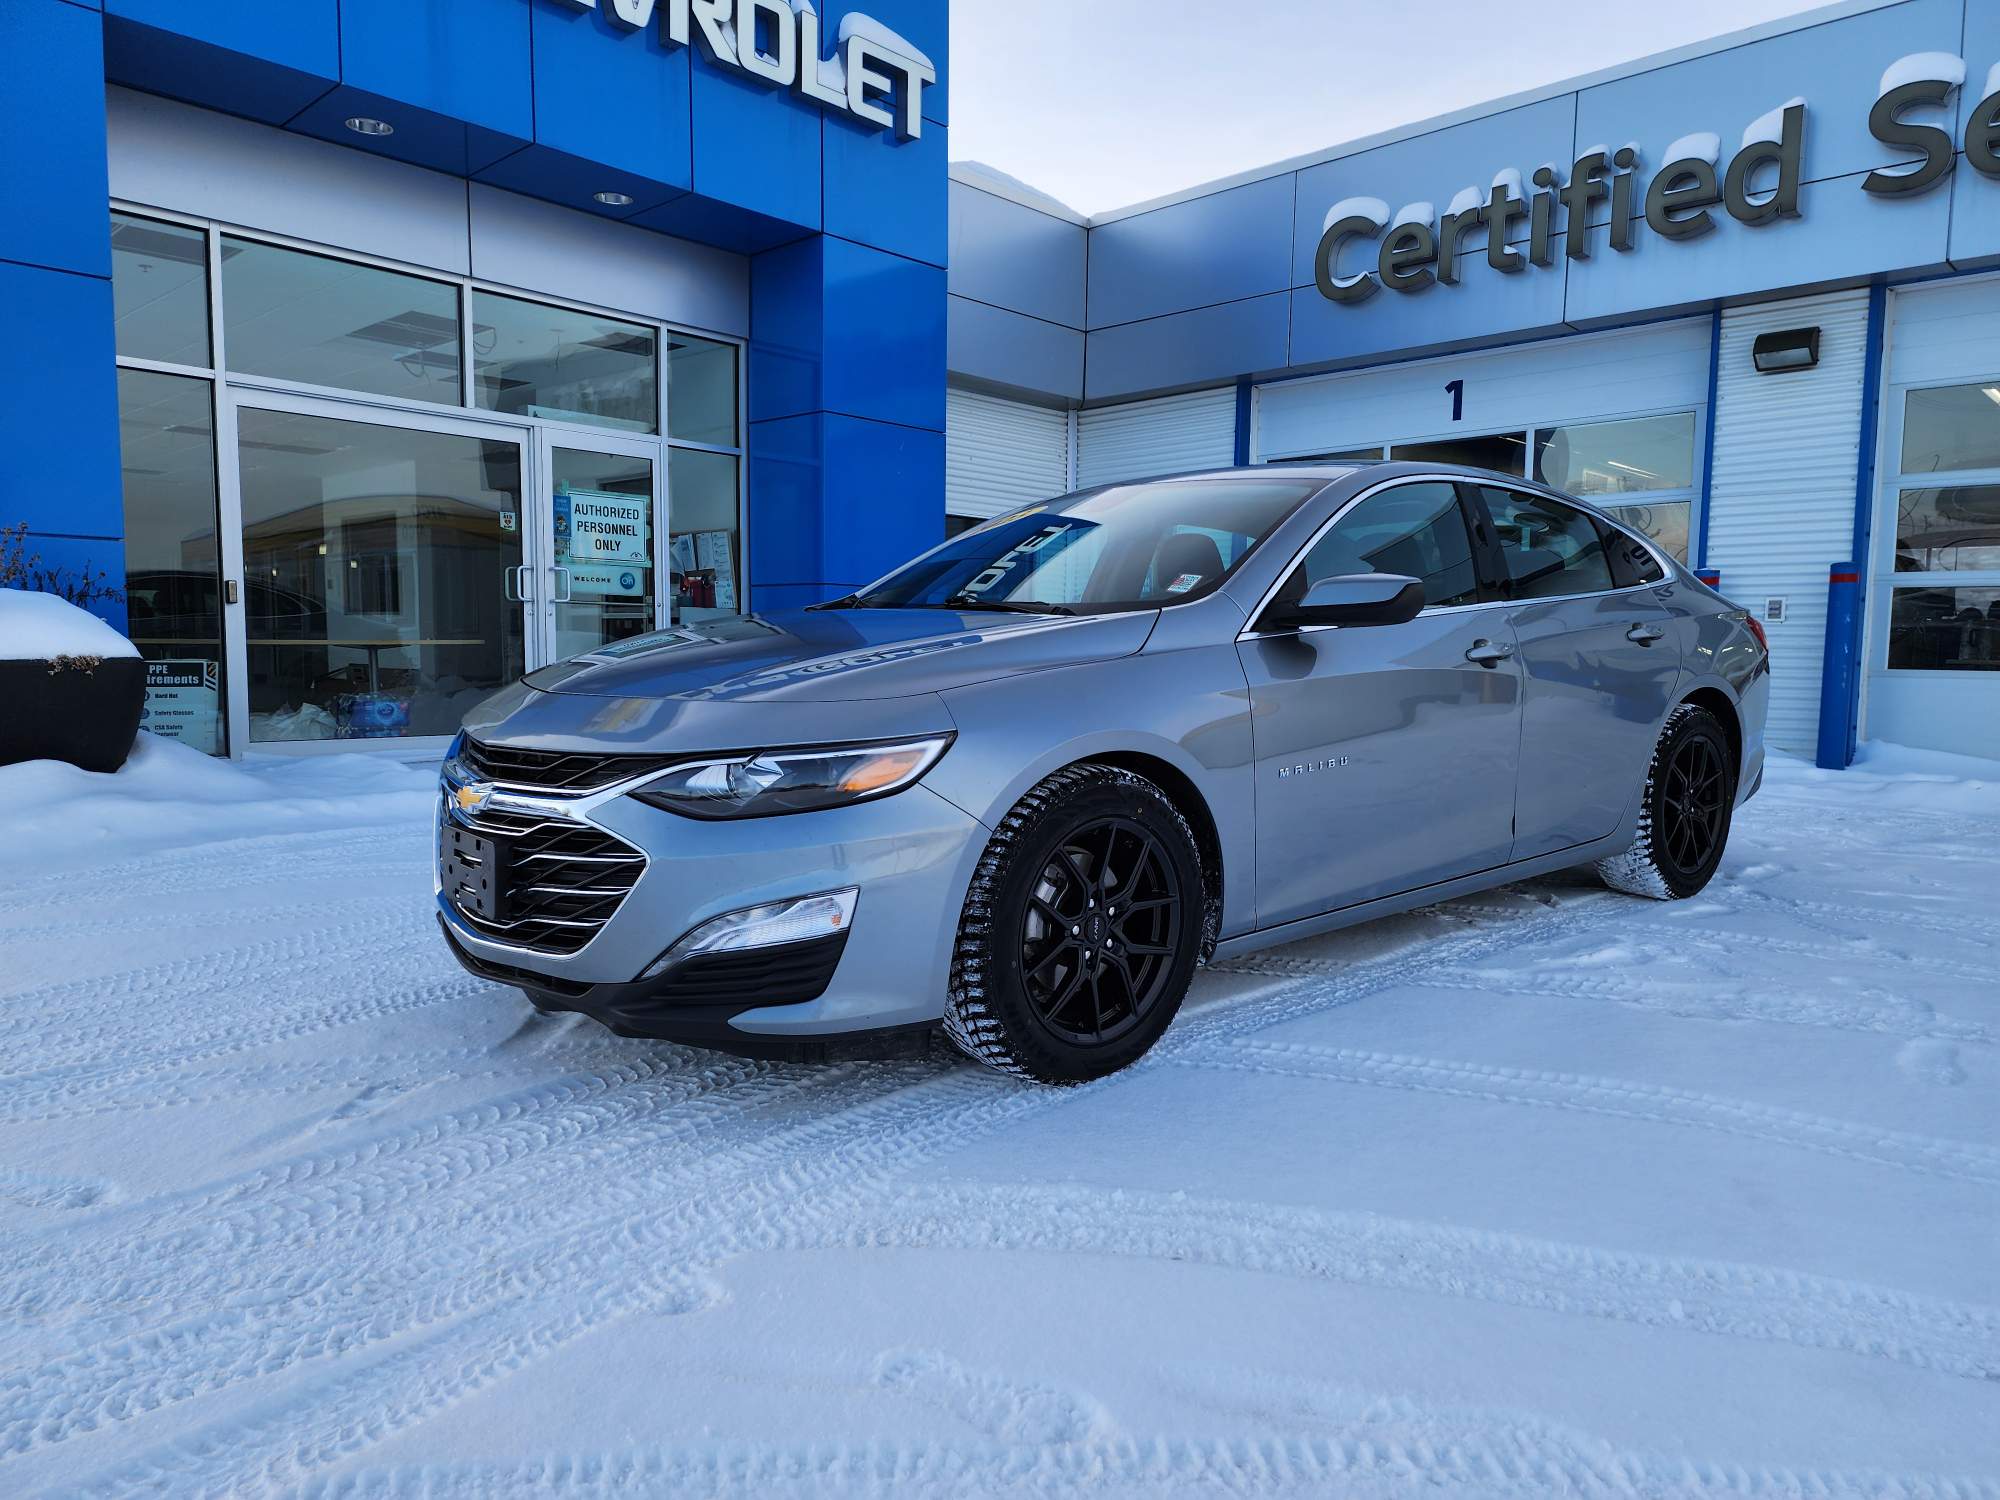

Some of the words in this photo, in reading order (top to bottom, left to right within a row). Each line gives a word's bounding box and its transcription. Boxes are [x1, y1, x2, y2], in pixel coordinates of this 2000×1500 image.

[576, 0, 936, 141] ROLET
[1315, 103, 1807, 303] Certified
[1444, 379, 1464, 421] 1
[574, 503, 640, 520] AUTHORIZED
[576, 520, 638, 537] PERSONNEL
[595, 538, 622, 552] ONLY
[574, 575, 612, 583] WELCOME
[149, 664, 168, 674] PPE
[146, 674, 200, 685] irements
[1278, 756, 1348, 778] MALIBU
